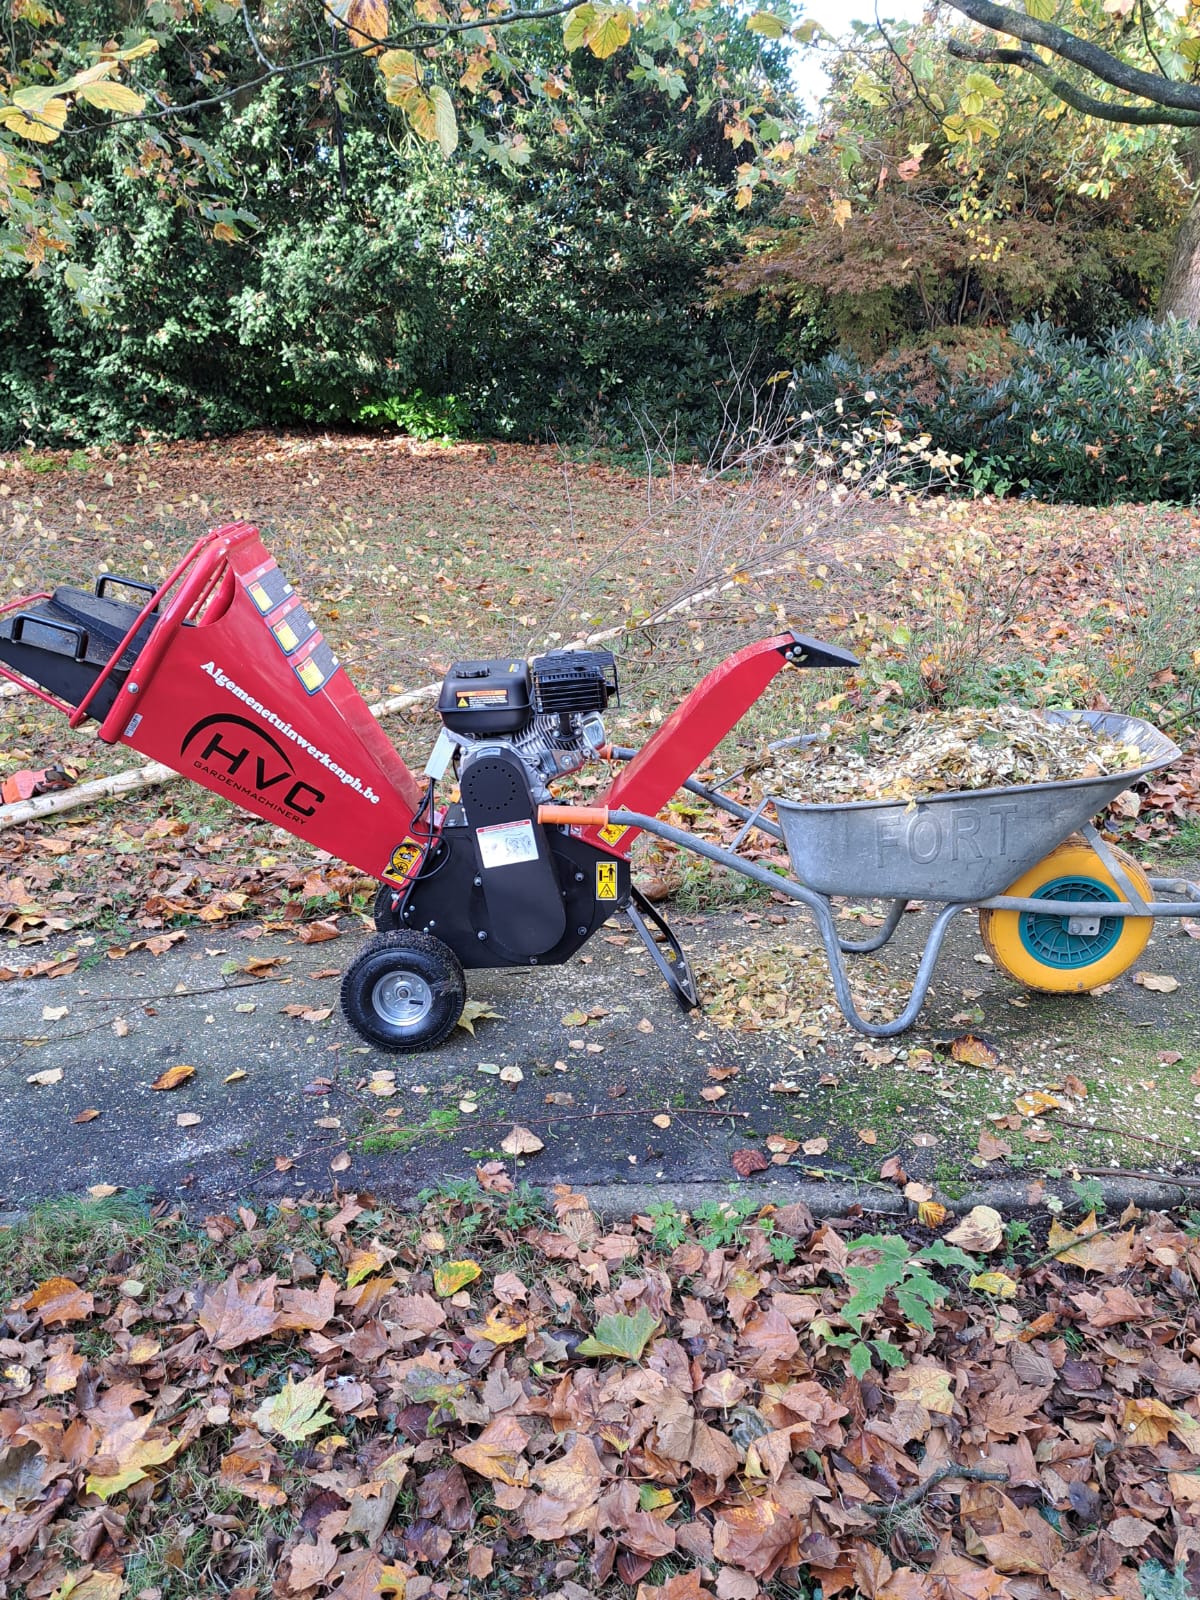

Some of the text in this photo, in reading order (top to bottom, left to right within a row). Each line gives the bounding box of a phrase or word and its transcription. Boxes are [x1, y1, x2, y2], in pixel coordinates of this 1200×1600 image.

[201, 661, 379, 804] Algemenetuinwerkenph.be
[193, 761, 307, 824] GARDENMACHINERY
[201, 733, 325, 816] HVC
[876, 803, 1017, 868] FORT
